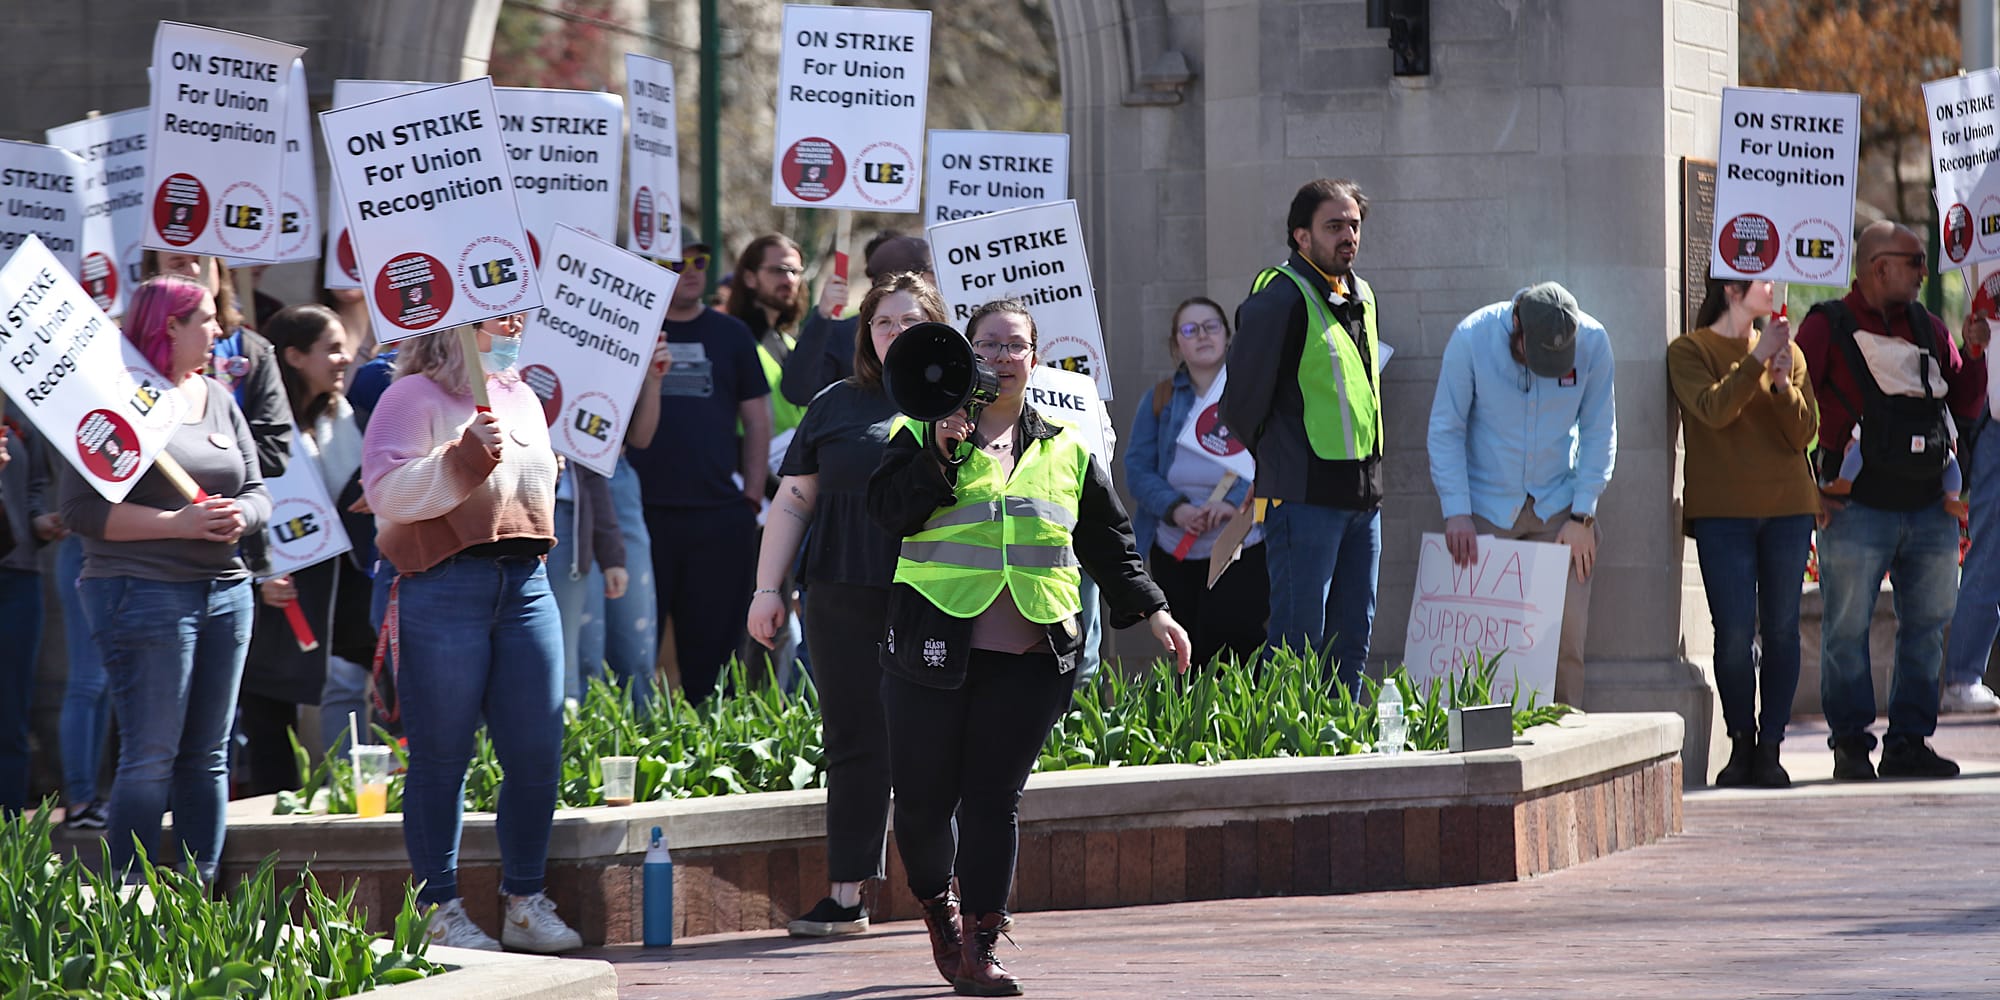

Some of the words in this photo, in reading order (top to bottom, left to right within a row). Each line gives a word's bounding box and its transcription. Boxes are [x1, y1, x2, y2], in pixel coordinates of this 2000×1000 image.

[797, 30, 828, 48] ON
[835, 32, 915, 53] STRIKE
[171, 51, 201, 73] ON
[208, 56, 278, 83] STRIKE
[803, 58, 837, 76] For
[844, 60, 905, 80] Union
[177, 83, 211, 105] For
[214, 88, 269, 113] Union
[789, 85, 916, 109] Recognition
[1936, 104, 1954, 122] ON
[1956, 94, 1996, 118] STRIKE
[164, 113, 276, 145] Recognition
[347, 130, 386, 157] ON
[392, 109, 484, 147] STRIKE
[531, 116, 608, 136] STRIKE
[1734, 111, 1765, 129] ON
[1770, 113, 1845, 135] STRIKE
[1942, 130, 1961, 147] For
[1963, 122, 1994, 143] Union
[89, 133, 147, 161] STRIKE
[539, 144, 599, 164] Union
[1740, 137, 1773, 156] For
[1777, 140, 1836, 161] Union
[364, 162, 405, 187] For
[412, 146, 482, 175] Union
[864, 162, 904, 185] UE
[941, 154, 973, 171] ON
[978, 155, 1054, 174] STRIKE
[1727, 163, 1846, 188] Recognition
[1, 168, 74, 194] STRIKE
[513, 173, 608, 194] cognition
[949, 180, 982, 197] For
[987, 181, 1045, 200] Union
[8, 199, 66, 222] Union
[358, 175, 503, 221] Recognition
[225, 204, 264, 231] UE
[948, 243, 981, 266] ON
[987, 228, 1068, 259] STRIKE
[1796, 238, 1835, 261] UE
[468, 257, 518, 289] UE
[556, 253, 588, 279] ON
[588, 267, 657, 310] STRIKE
[961, 272, 996, 292] For
[1002, 259, 1065, 284] Union
[6, 267, 57, 329] STRIKE
[554, 283, 585, 309] For
[588, 298, 641, 335] Union
[10, 343, 40, 375] For
[34, 299, 76, 345] Union
[536, 307, 641, 368] Recognition
[24, 316, 103, 408] Recognition
[1026, 387, 1087, 412] RIKE
[574, 407, 613, 443] UE
[1419, 539, 1524, 601] CWA
[1410, 602, 1535, 651] SUPPORTS
